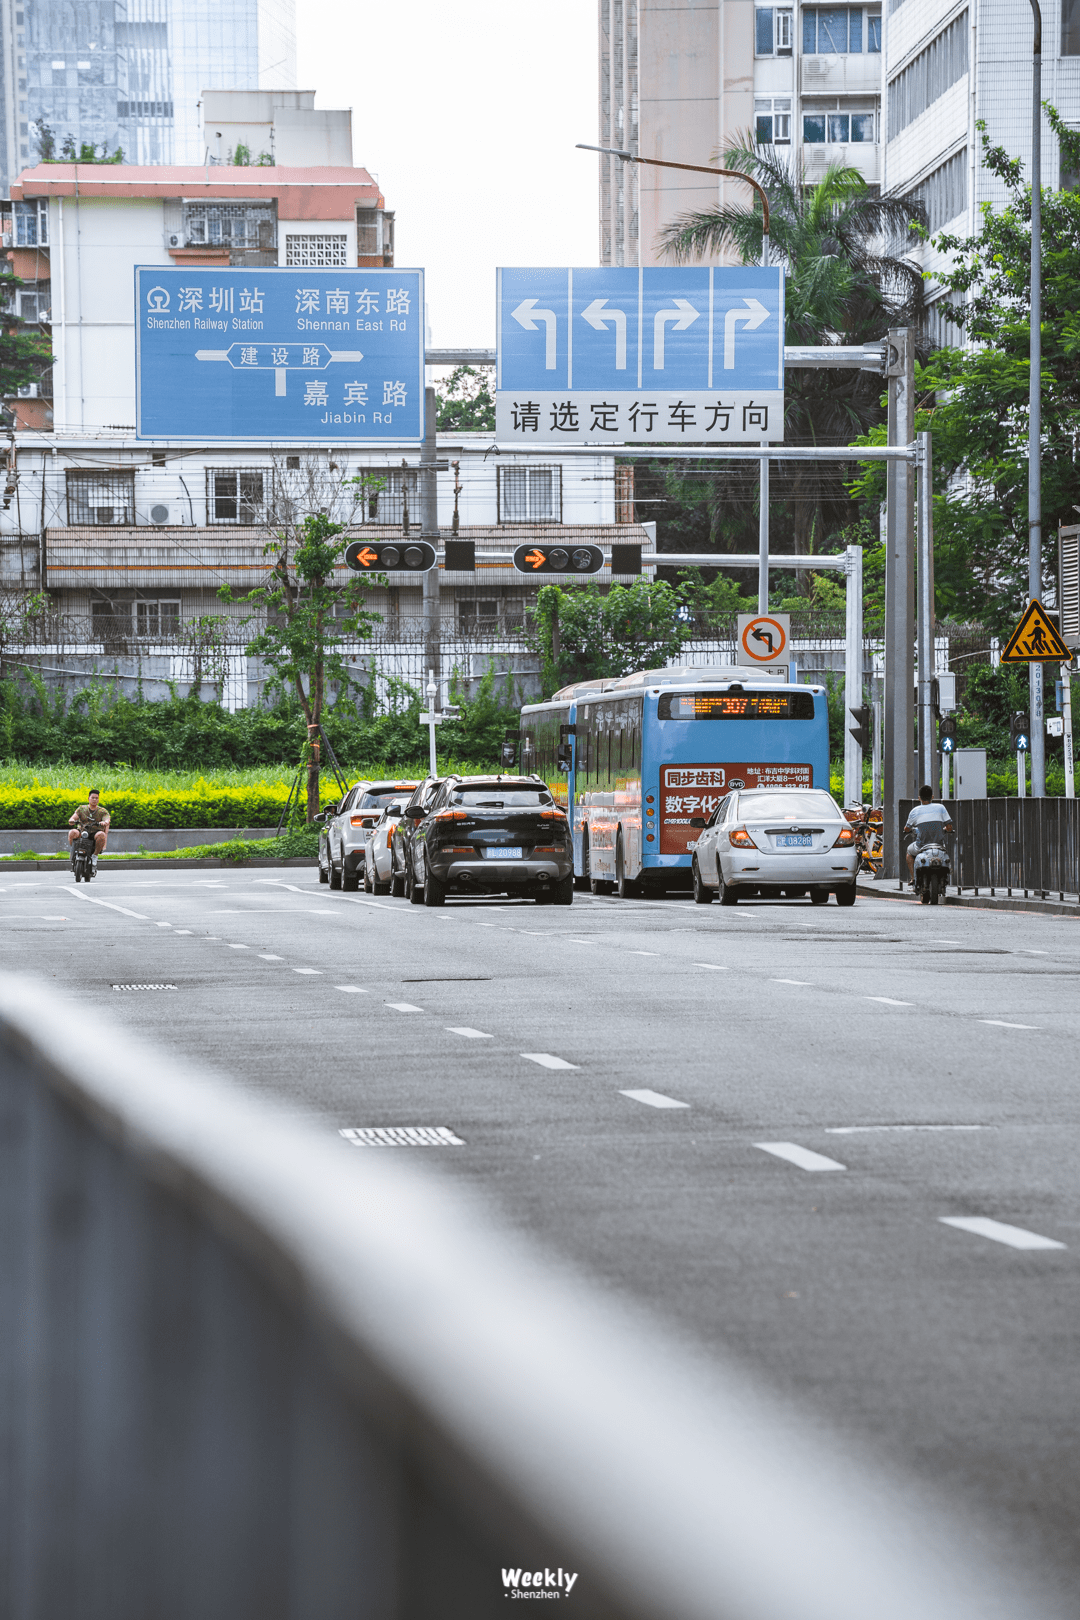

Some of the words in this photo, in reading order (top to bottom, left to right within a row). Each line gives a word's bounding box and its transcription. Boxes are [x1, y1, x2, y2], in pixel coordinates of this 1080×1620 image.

[177, 286, 265, 314] 深圳站
[295, 288, 412, 315] 深南东路
[146, 317, 191, 330] Shenzhen
[194, 317, 228, 332] Railway
[232, 317, 264, 330] Station
[297, 318, 350, 331] Shennan
[356, 319, 383, 331] East
[390, 319, 407, 331] Rd
[240, 346, 322, 366] 建设路
[303, 380, 408, 407] 嘉宾路
[320, 411, 366, 424] Jiabin
[373, 412, 392, 424] Rd
[510, 400, 769, 433] 请选定行车方向
[667, 771, 724, 786] 同步齿科
[665, 795, 725, 814] 数字化
